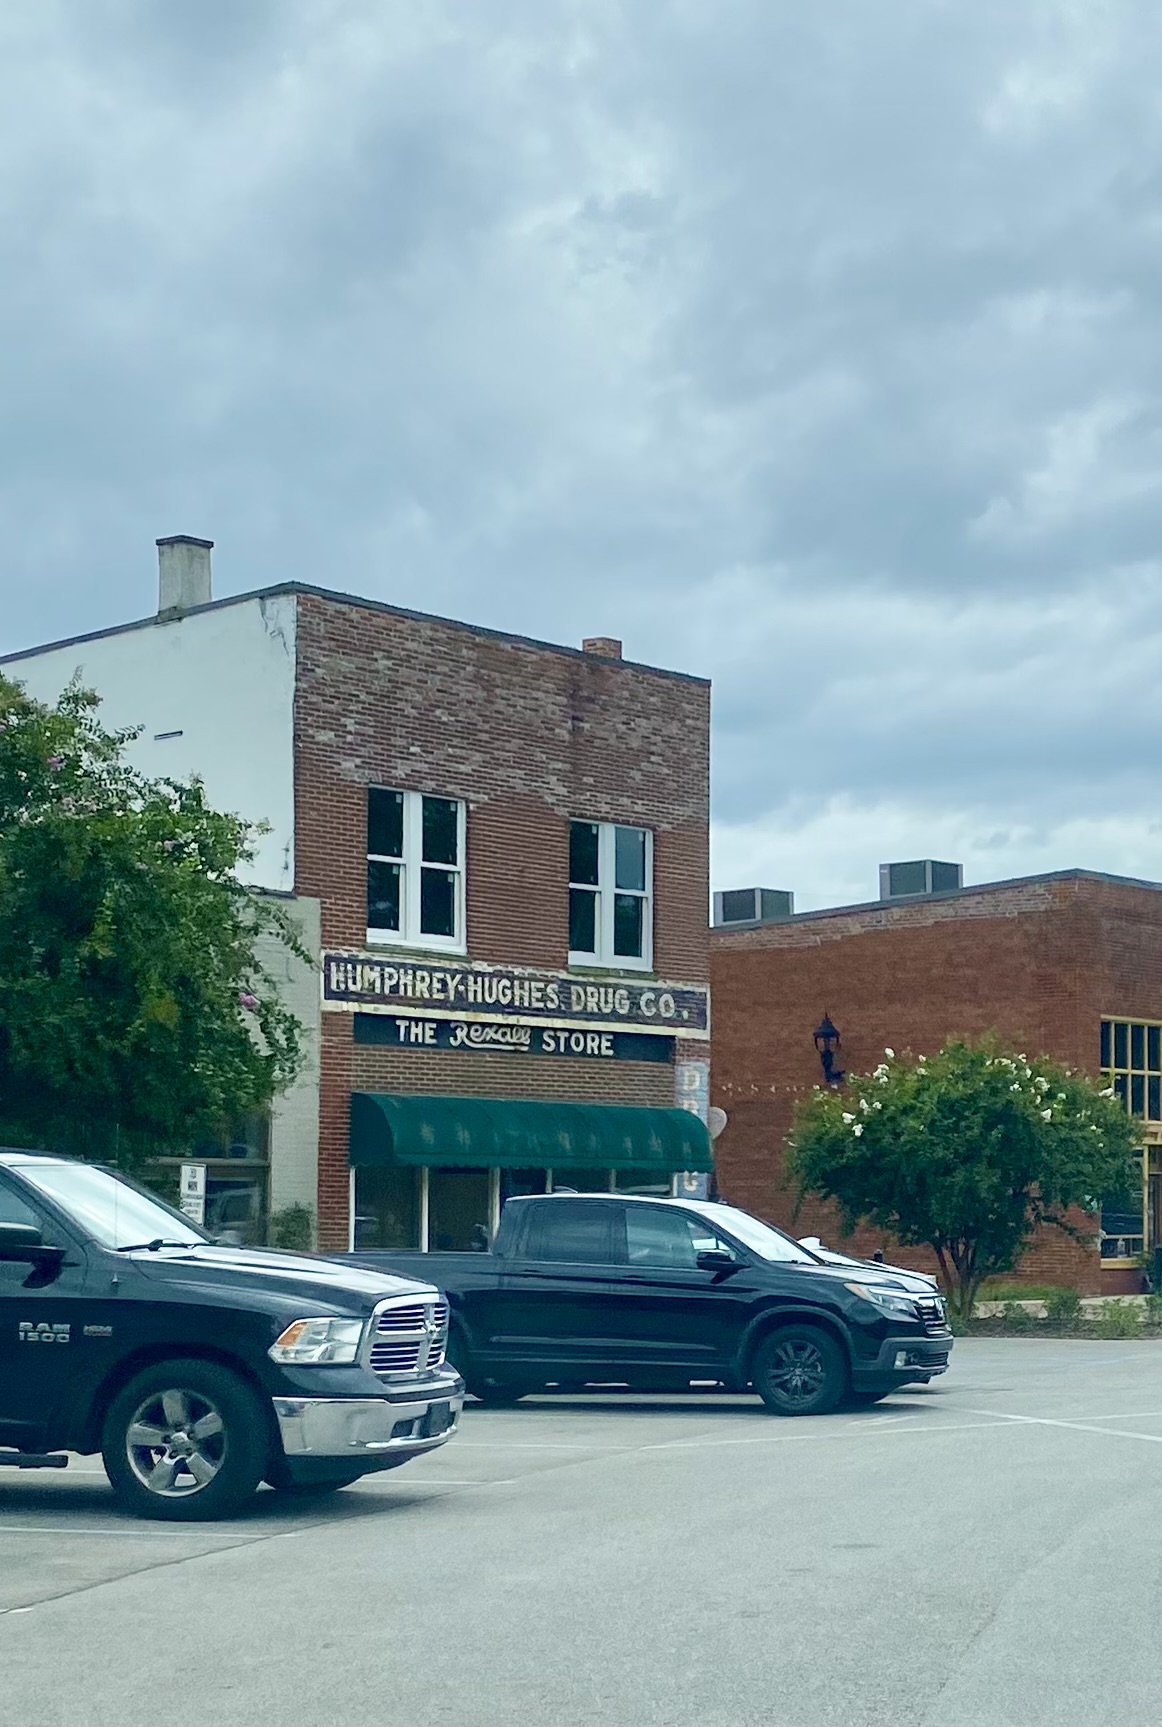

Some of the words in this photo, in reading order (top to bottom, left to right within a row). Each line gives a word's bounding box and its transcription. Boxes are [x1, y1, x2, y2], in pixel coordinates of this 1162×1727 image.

[571, 985, 630, 1014] DRUG
[639, 991, 689, 1020] CO.
[396, 1019, 438, 1045] THE
[449, 1021, 531, 1052] Rexall
[542, 1034, 614, 1056] STORE
[19, 1322, 71, 1333] RAM
[19, 1331, 70, 1343] 1500
